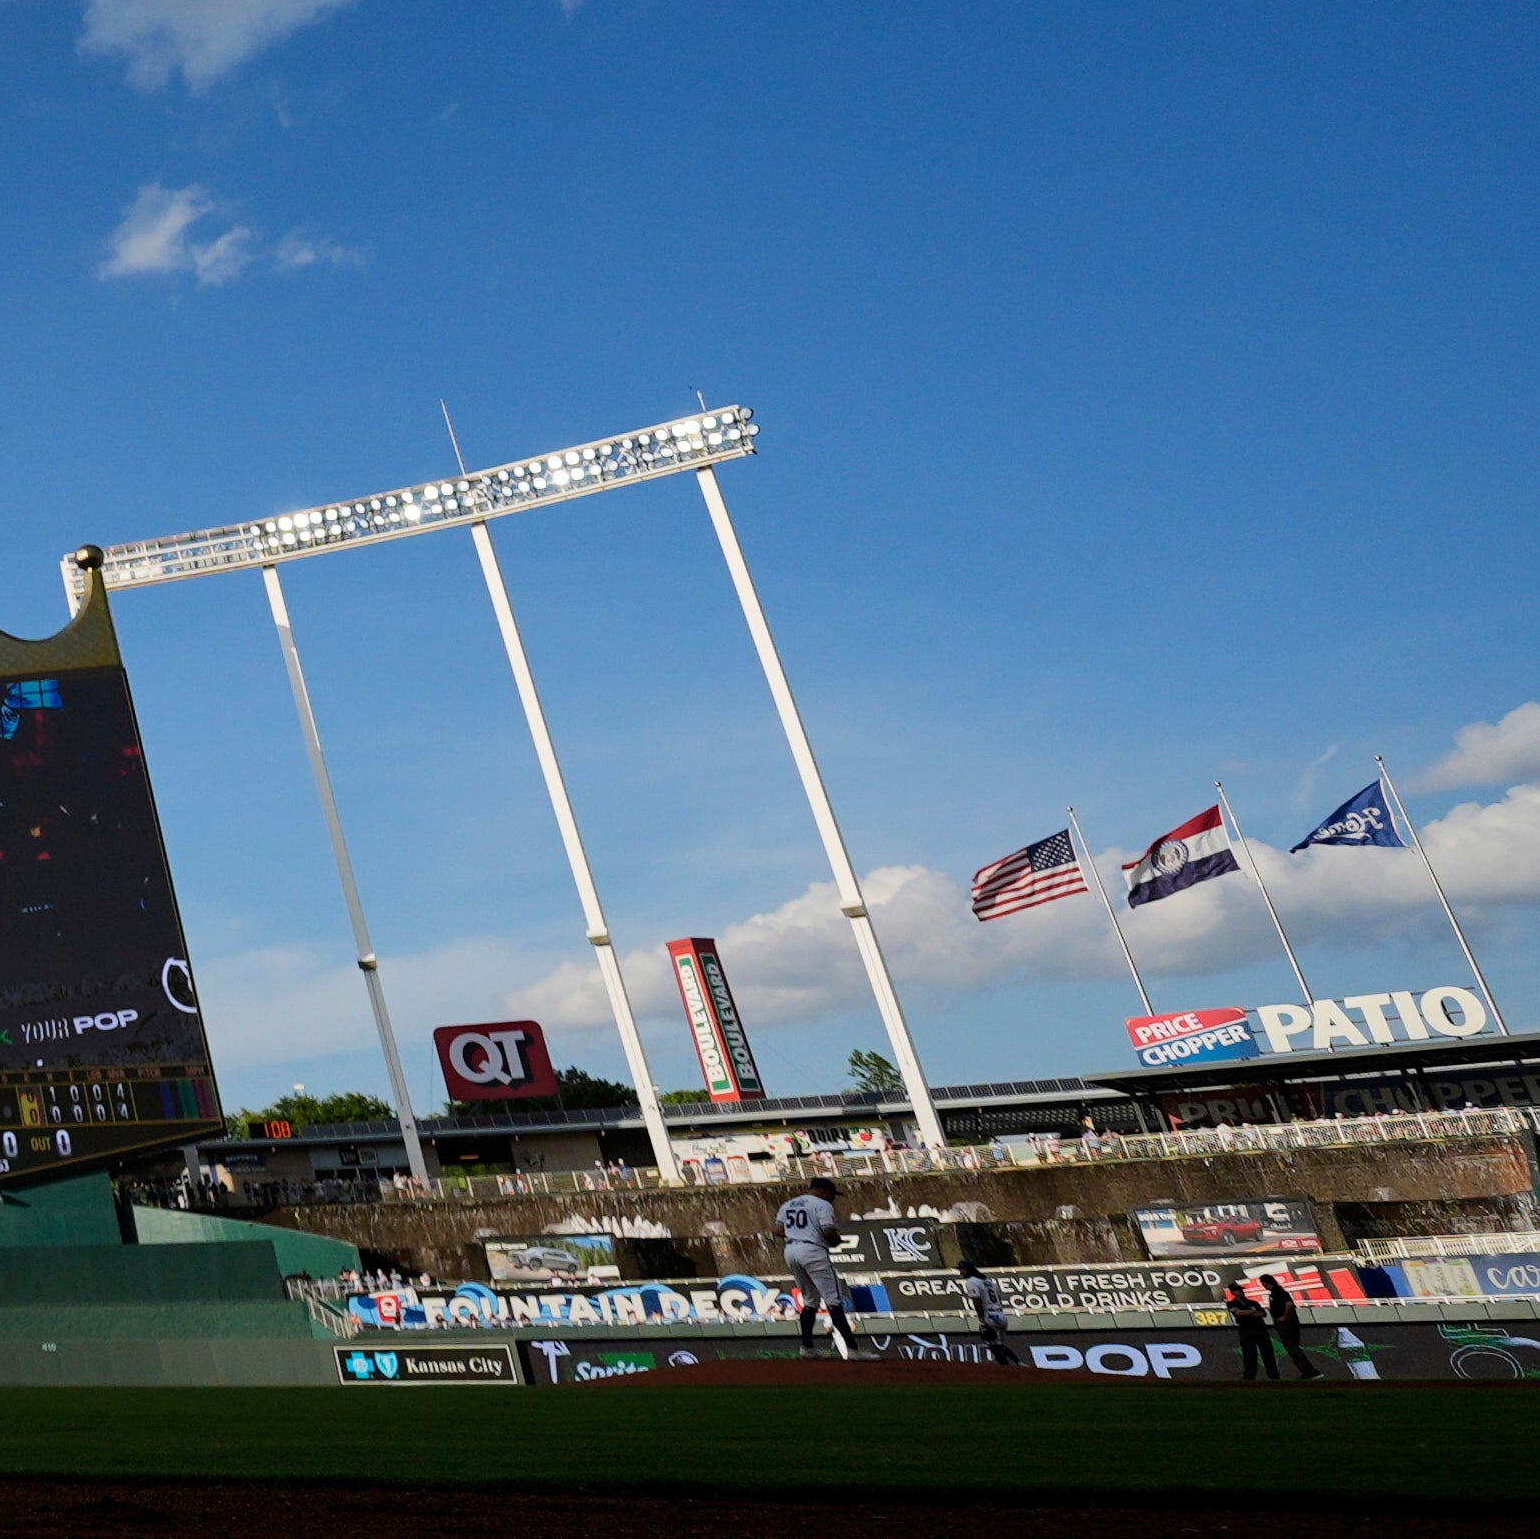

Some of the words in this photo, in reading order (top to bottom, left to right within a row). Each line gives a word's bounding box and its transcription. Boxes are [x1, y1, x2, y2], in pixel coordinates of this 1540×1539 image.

[21, 1018, 70, 1044] YOUR
[73, 1009, 138, 1035] POP
[681, 964, 725, 1082] BOULEVARD
[706, 962, 752, 1079] BOULEVARD
[1134, 1013, 1203, 1044] PRICE
[1256, 986, 1487, 1053] PATIO
[449, 1029, 525, 1086] QT
[1142, 1025, 1251, 1066] CHOPPER
[70, 1084, 80, 1103] 0
[92, 1083, 102, 1102] 0
[52, 1105, 62, 1124] 0
[73, 1104, 84, 1123] 0
[96, 1103, 106, 1122] 0
[2, 1131, 19, 1158] 0
[30, 1137, 52, 1153] OUT
[55, 1129, 72, 1156] 0
[786, 1209, 808, 1229] 50
[899, 1279, 971, 1298] GREAT
[1066, 1273, 1146, 1291] FRESH
[1151, 1270, 1221, 1288] FOOD
[422, 1292, 647, 1326] FOUNTAIN
[658, 1288, 782, 1320] DECK
[962, 1292, 1075, 1311] I-COLD
[1082, 1290, 1171, 1308] DRINKS
[1195, 1313, 1228, 1325] 387
[406, 1357, 466, 1374] Kansas
[469, 1357, 503, 1376] City
[1029, 1343, 1203, 1379] POP
